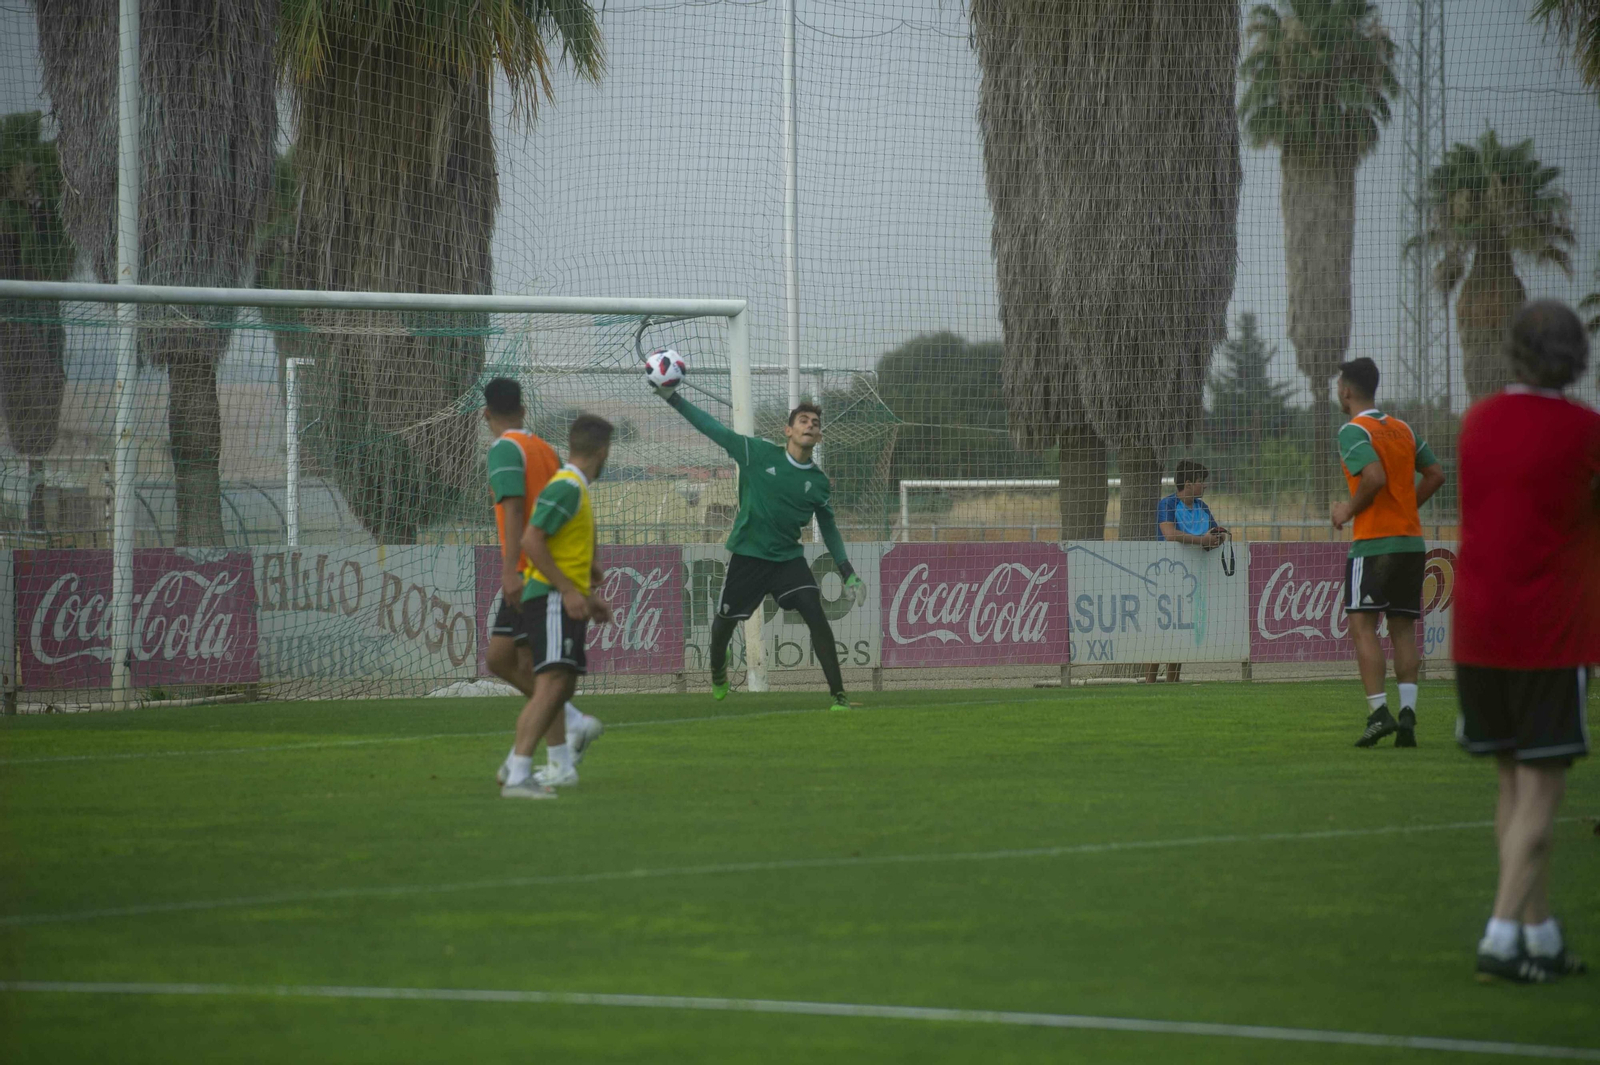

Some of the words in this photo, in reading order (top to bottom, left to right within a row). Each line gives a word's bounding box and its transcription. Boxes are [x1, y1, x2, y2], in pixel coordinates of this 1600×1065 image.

[255, 552, 364, 617] ALLO
[889, 563, 1059, 645] Coca-Cola
[1086, 639, 1114, 661] XXI
